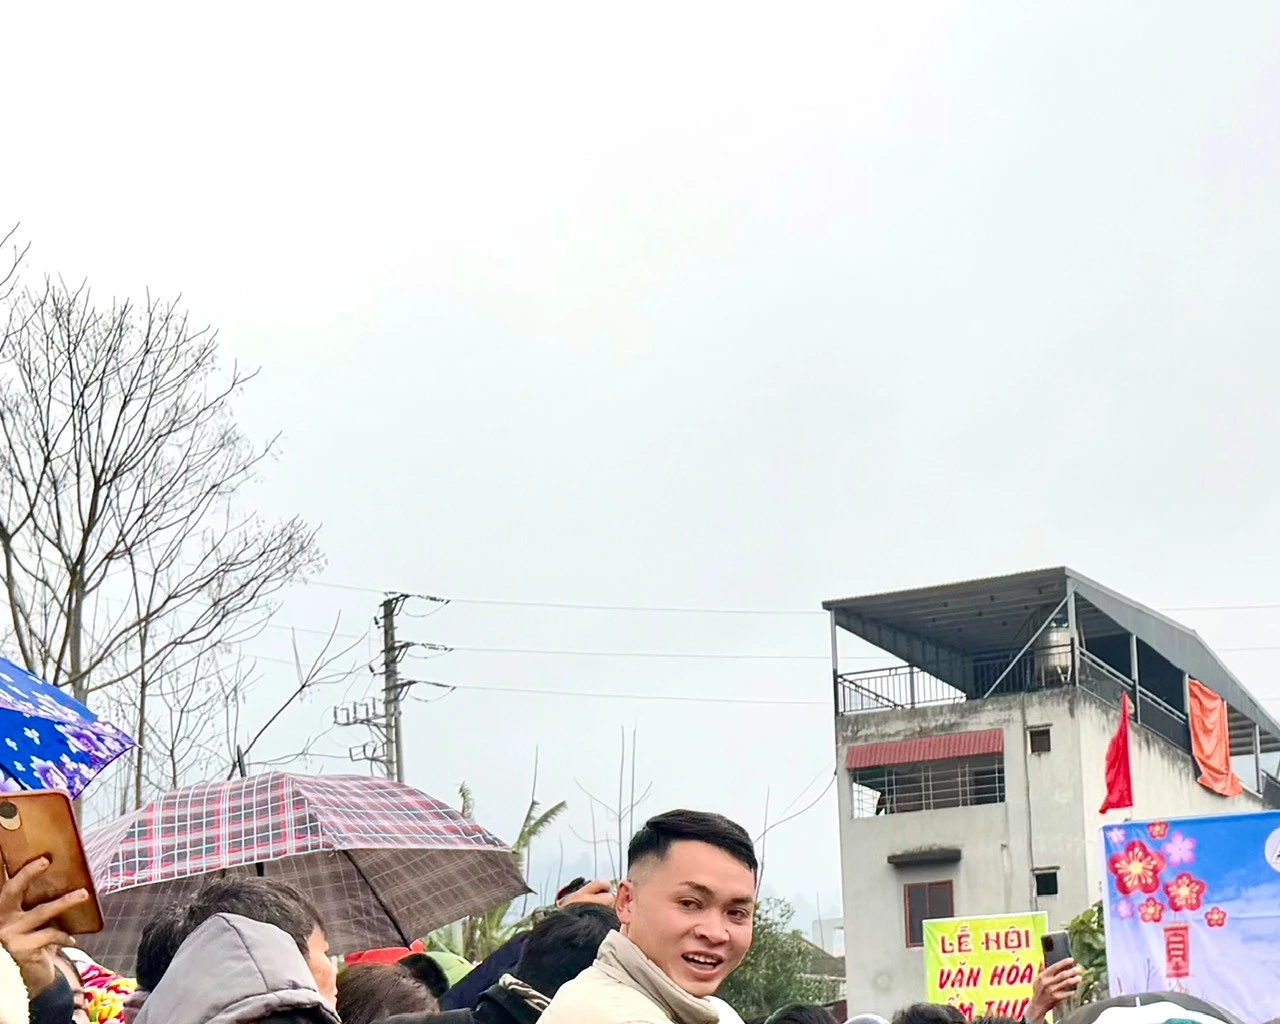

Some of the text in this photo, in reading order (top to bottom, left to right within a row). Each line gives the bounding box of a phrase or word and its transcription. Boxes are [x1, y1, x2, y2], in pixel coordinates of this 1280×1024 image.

[940, 926, 1031, 954] LỄ HỘI
[938, 957, 1034, 990] VĂN HÓA
